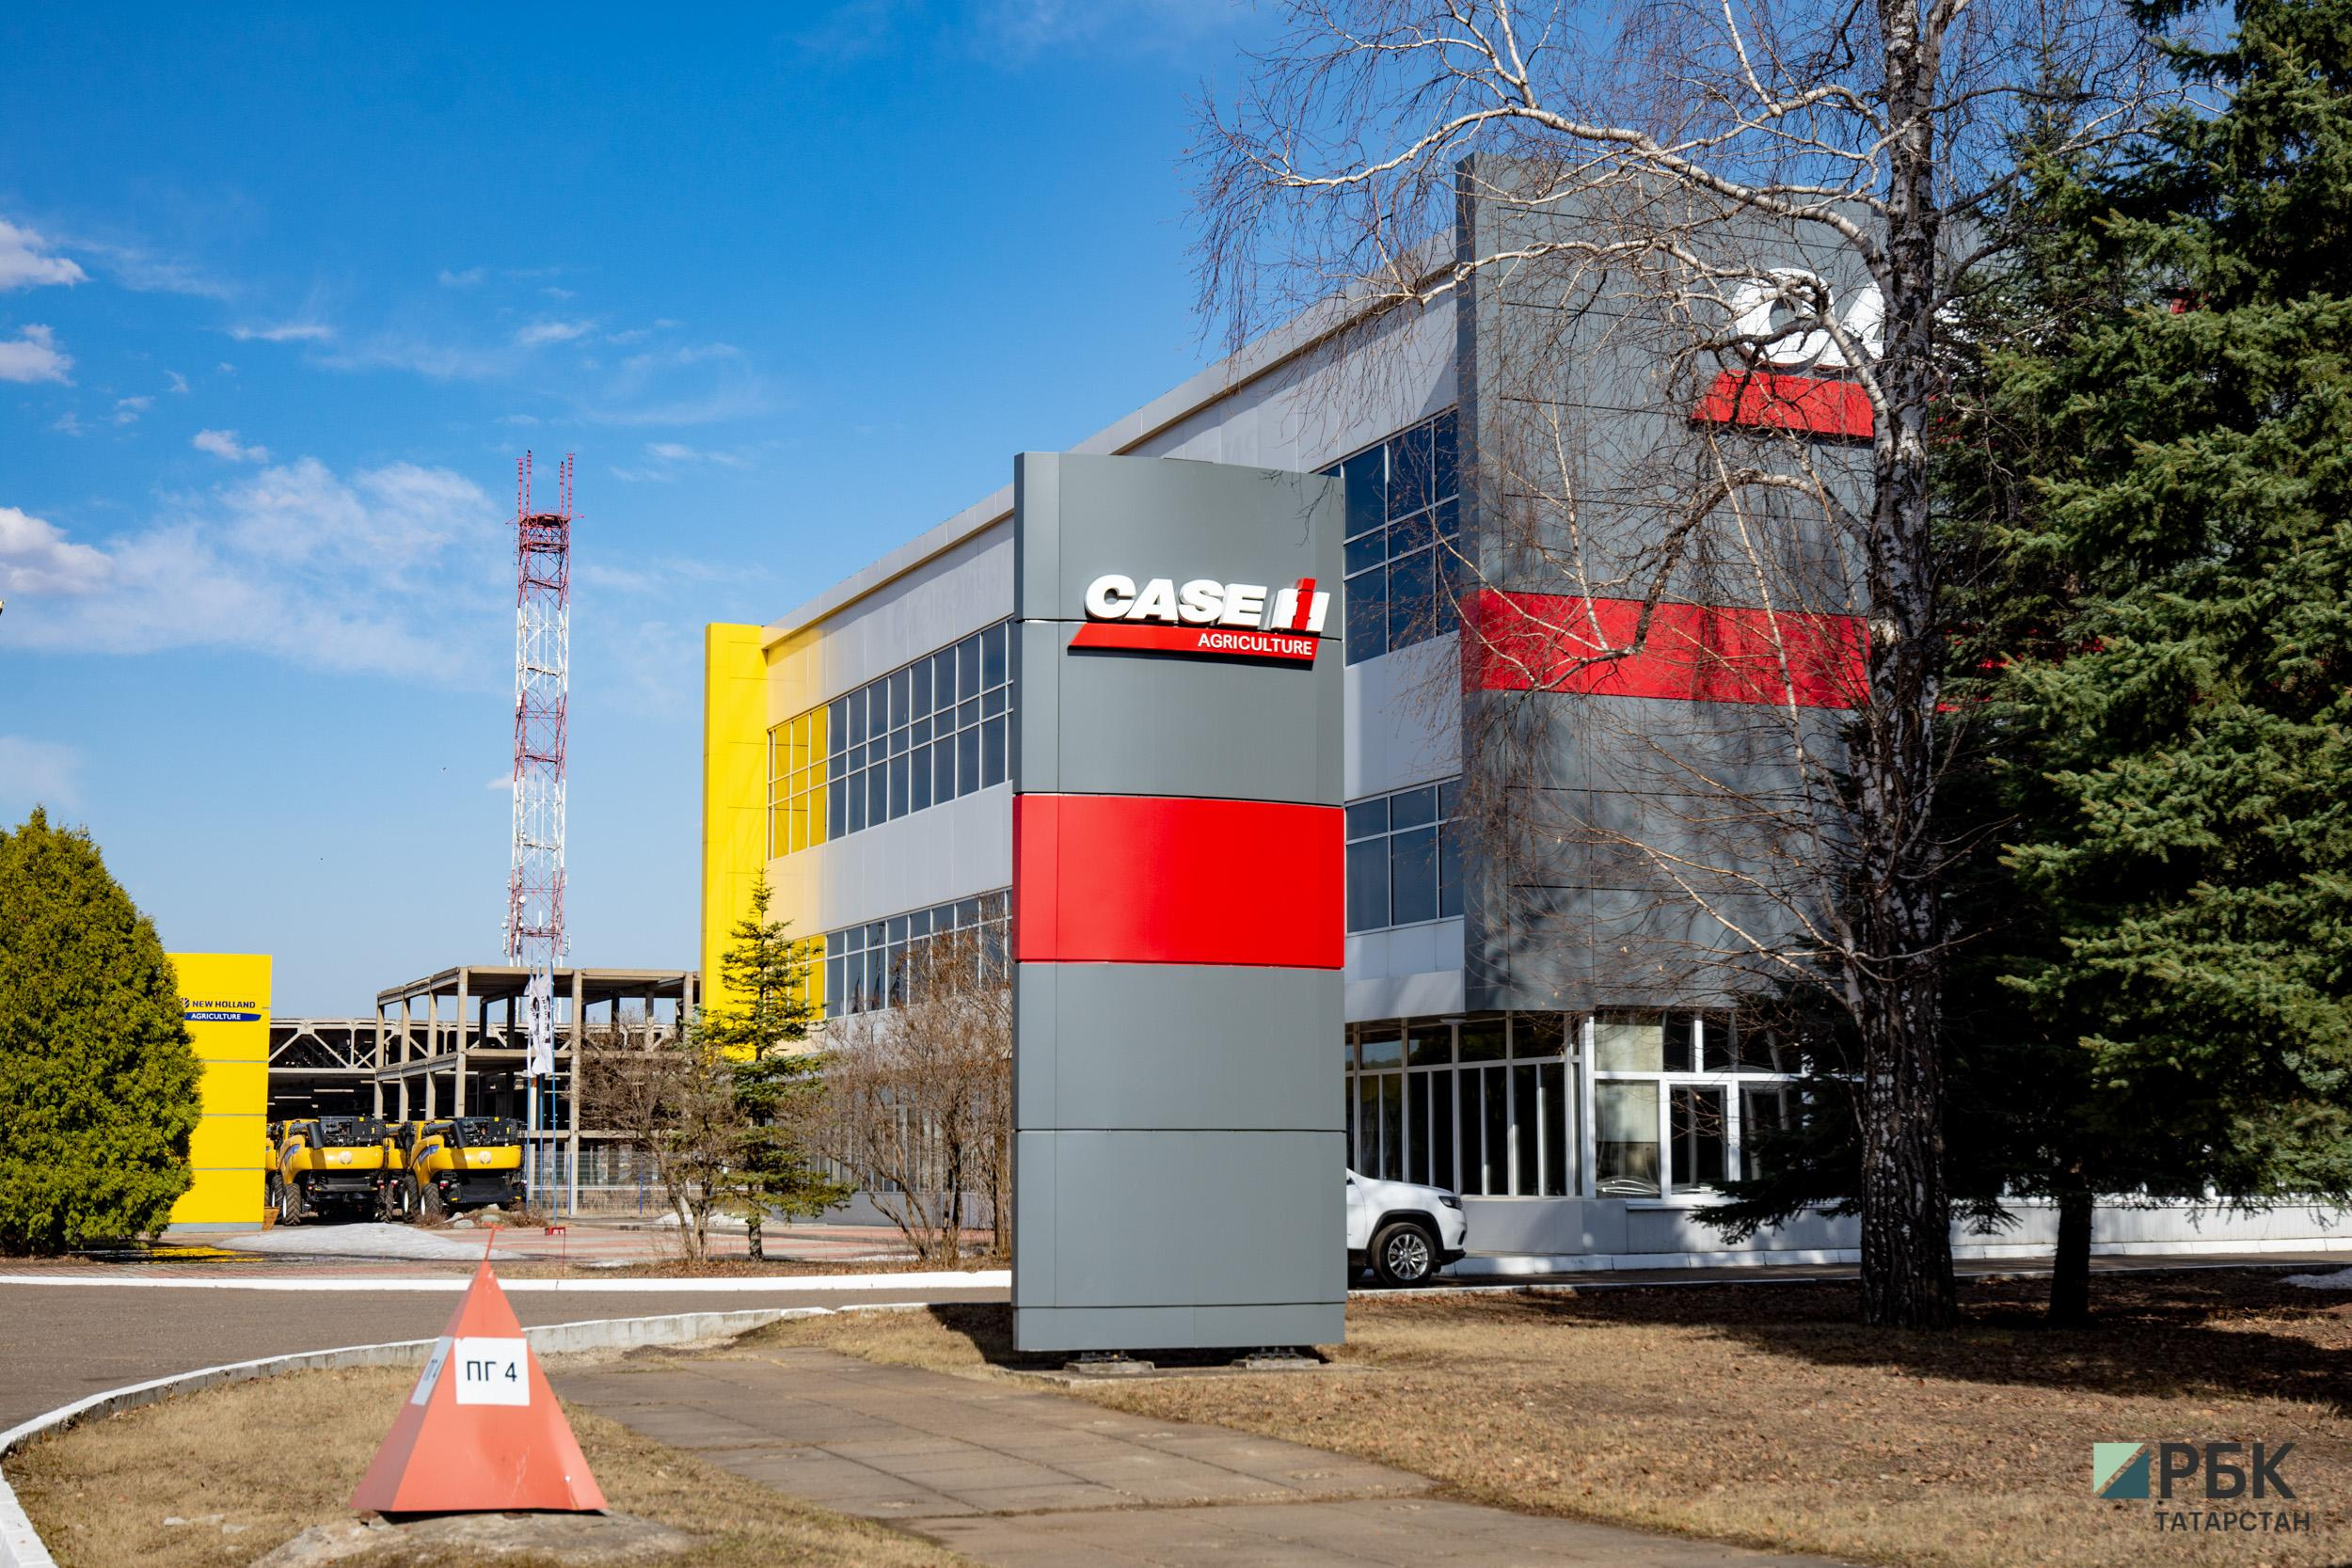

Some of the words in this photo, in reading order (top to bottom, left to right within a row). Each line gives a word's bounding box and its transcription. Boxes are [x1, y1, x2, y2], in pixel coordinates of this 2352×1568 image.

[1084, 574, 1267, 626] CASE
[1198, 633, 1312, 656] AGRICULTURE
[192, 1000, 213, 1008] NEW
[215, 1001, 256, 1009] HOLLAND
[191, 1012, 242, 1021] AGRICULTURE
[466, 1360, 497, 1382] ПГ
[504, 1361, 517, 1383] 4
